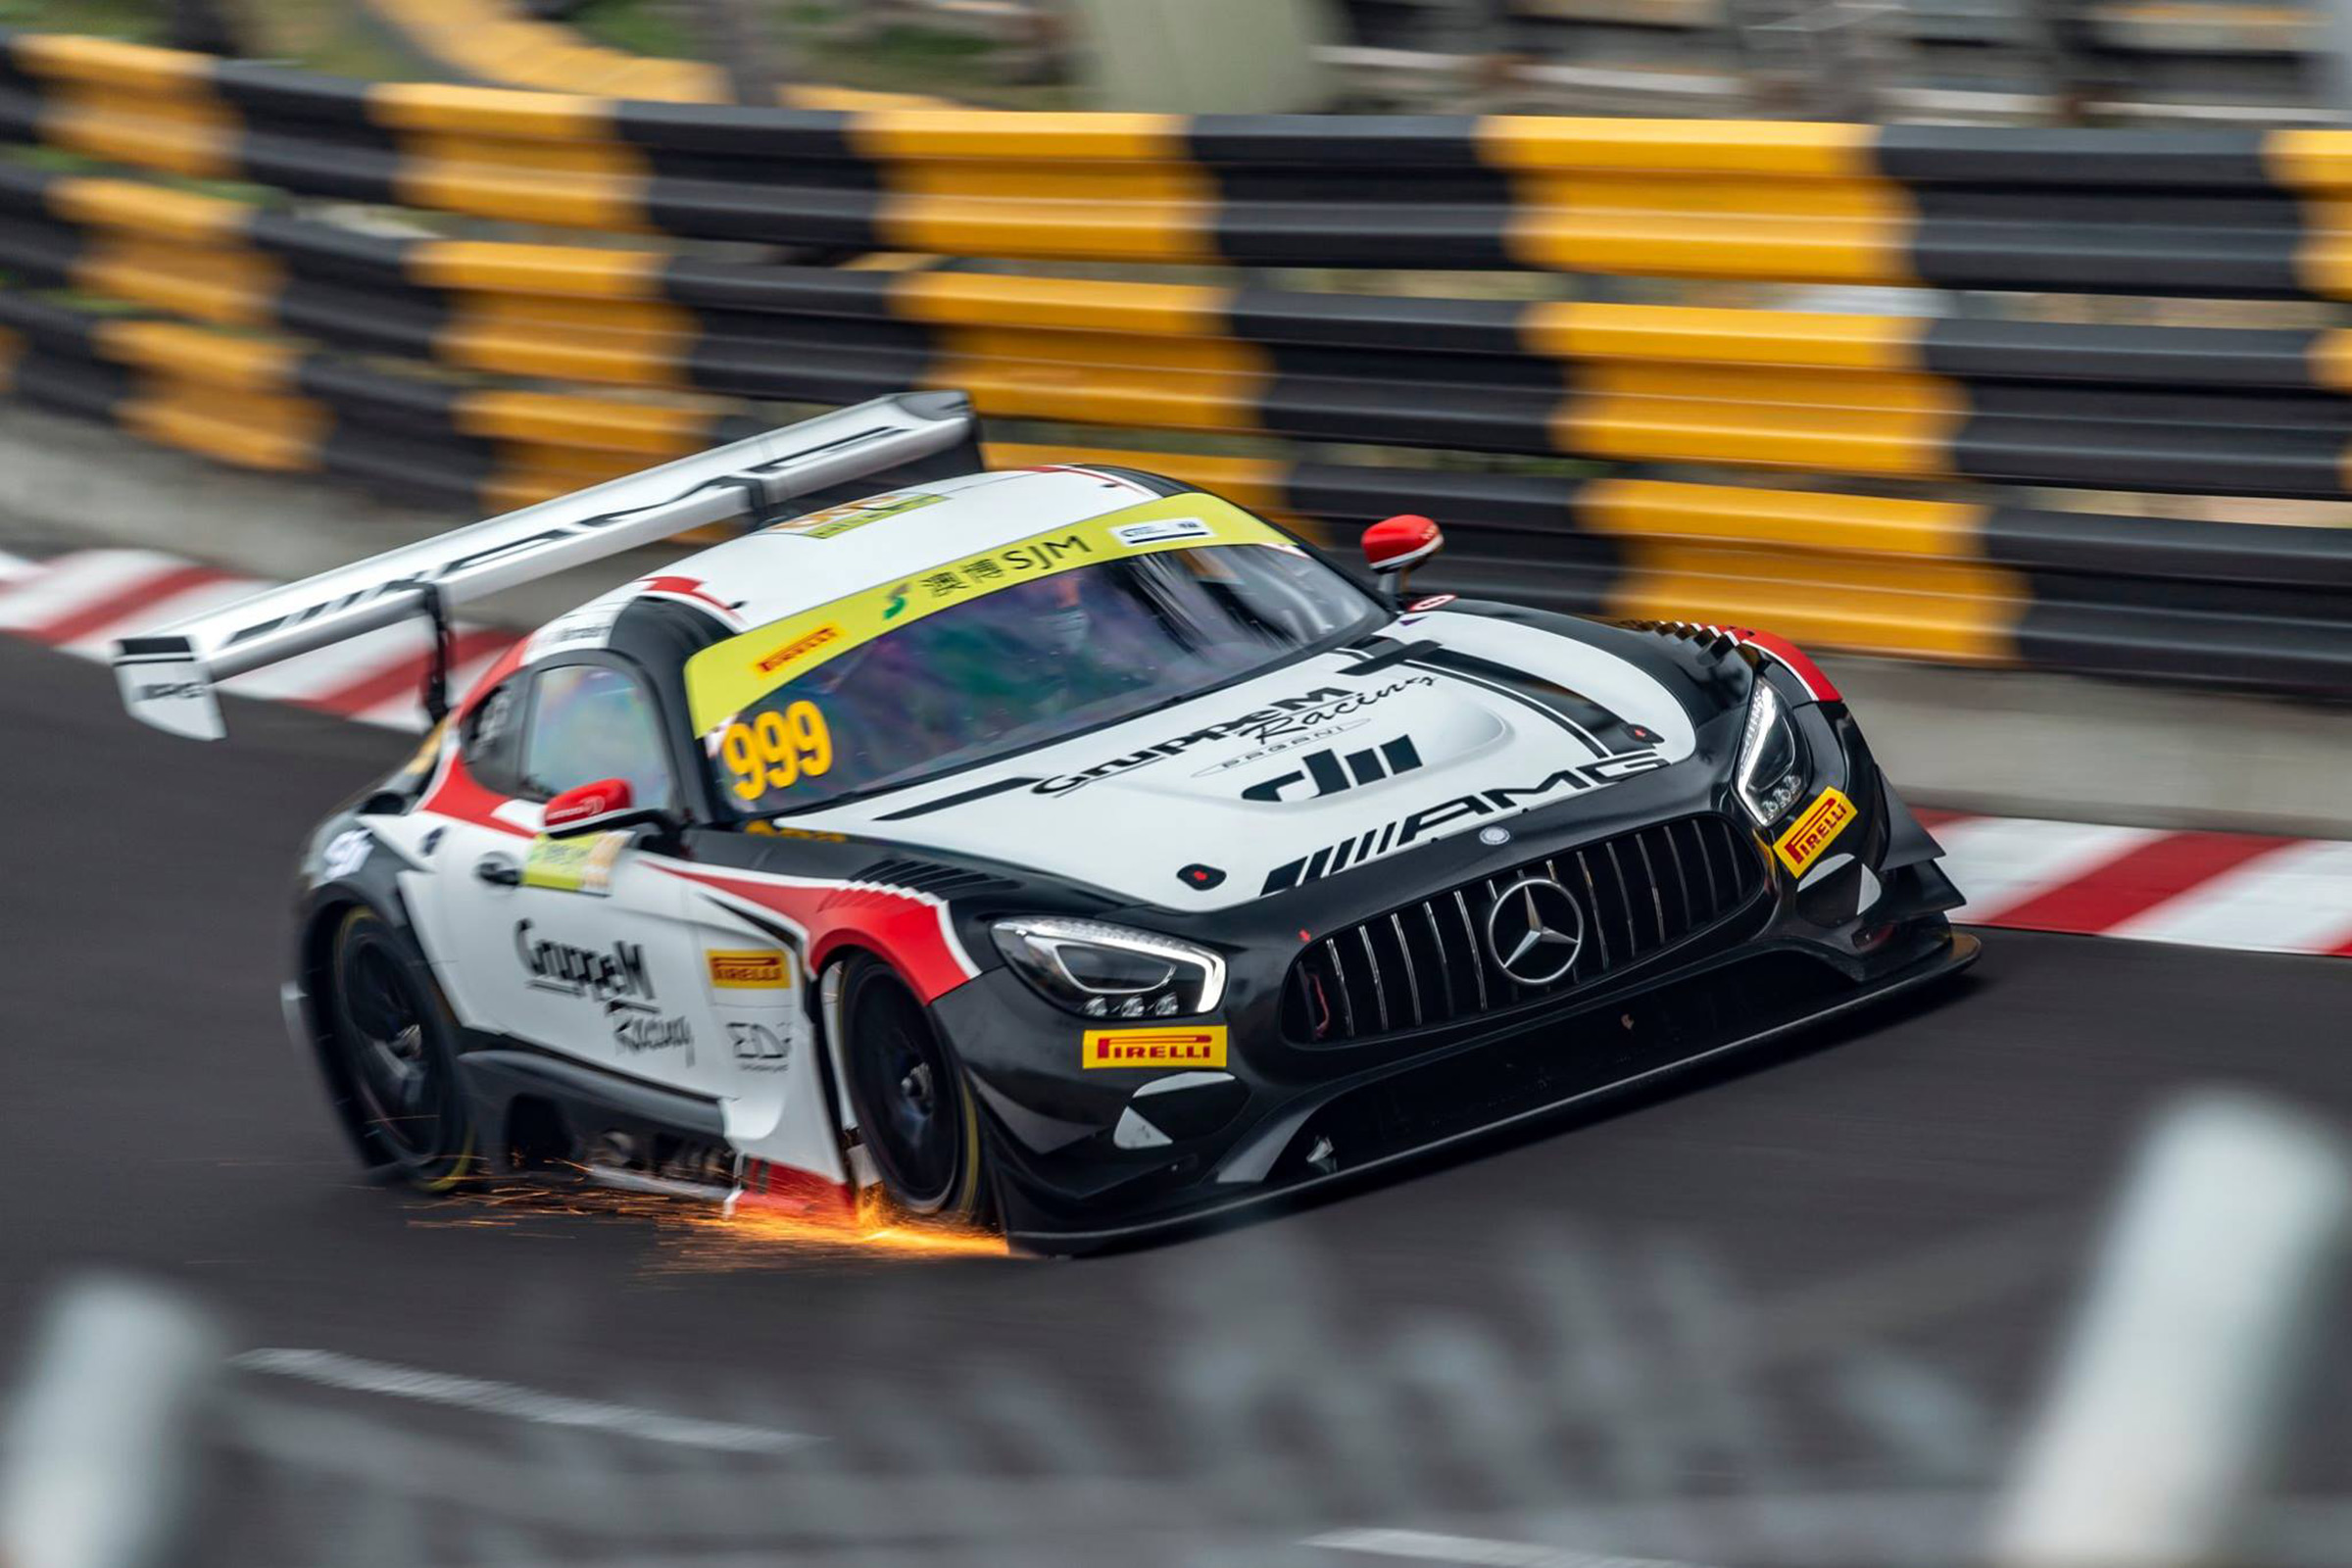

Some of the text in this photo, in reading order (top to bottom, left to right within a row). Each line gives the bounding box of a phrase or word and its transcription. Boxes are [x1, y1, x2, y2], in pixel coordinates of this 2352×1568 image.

[1003, 535, 1093, 569] SJM
[758, 627, 838, 672] PIRELLI
[1237, 675, 1439, 746] Racing
[722, 699, 833, 801] 999
[1222, 726, 1345, 768] PAGANI
[1784, 797, 1847, 865] PIRELLI
[710, 956, 781, 981] PIRELLI
[1097, 1034, 1212, 1059] PIRELLI
